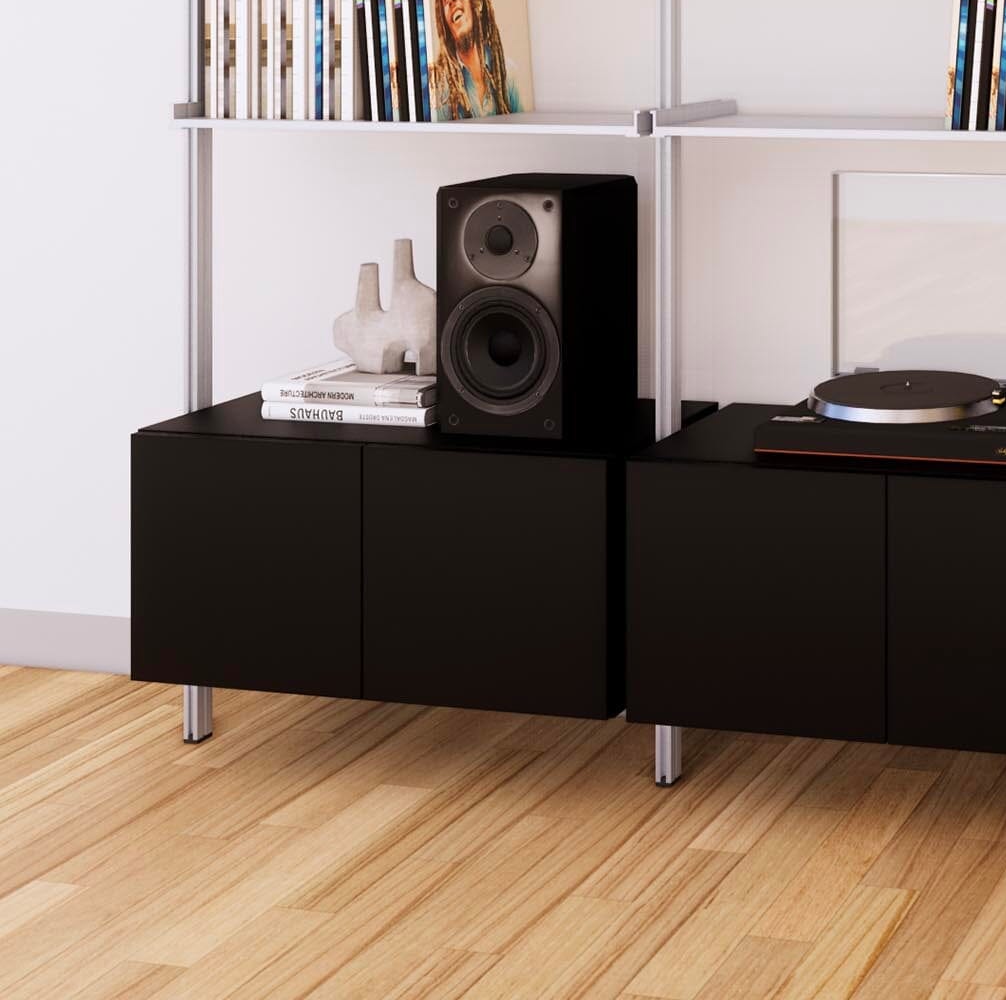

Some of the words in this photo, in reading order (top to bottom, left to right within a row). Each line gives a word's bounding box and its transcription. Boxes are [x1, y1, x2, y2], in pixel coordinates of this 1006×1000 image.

[280, 389, 326, 399] ARCHITECTURE
[327, 391, 354, 400] MODERN
[290, 407, 344, 421] BAUHAUS
